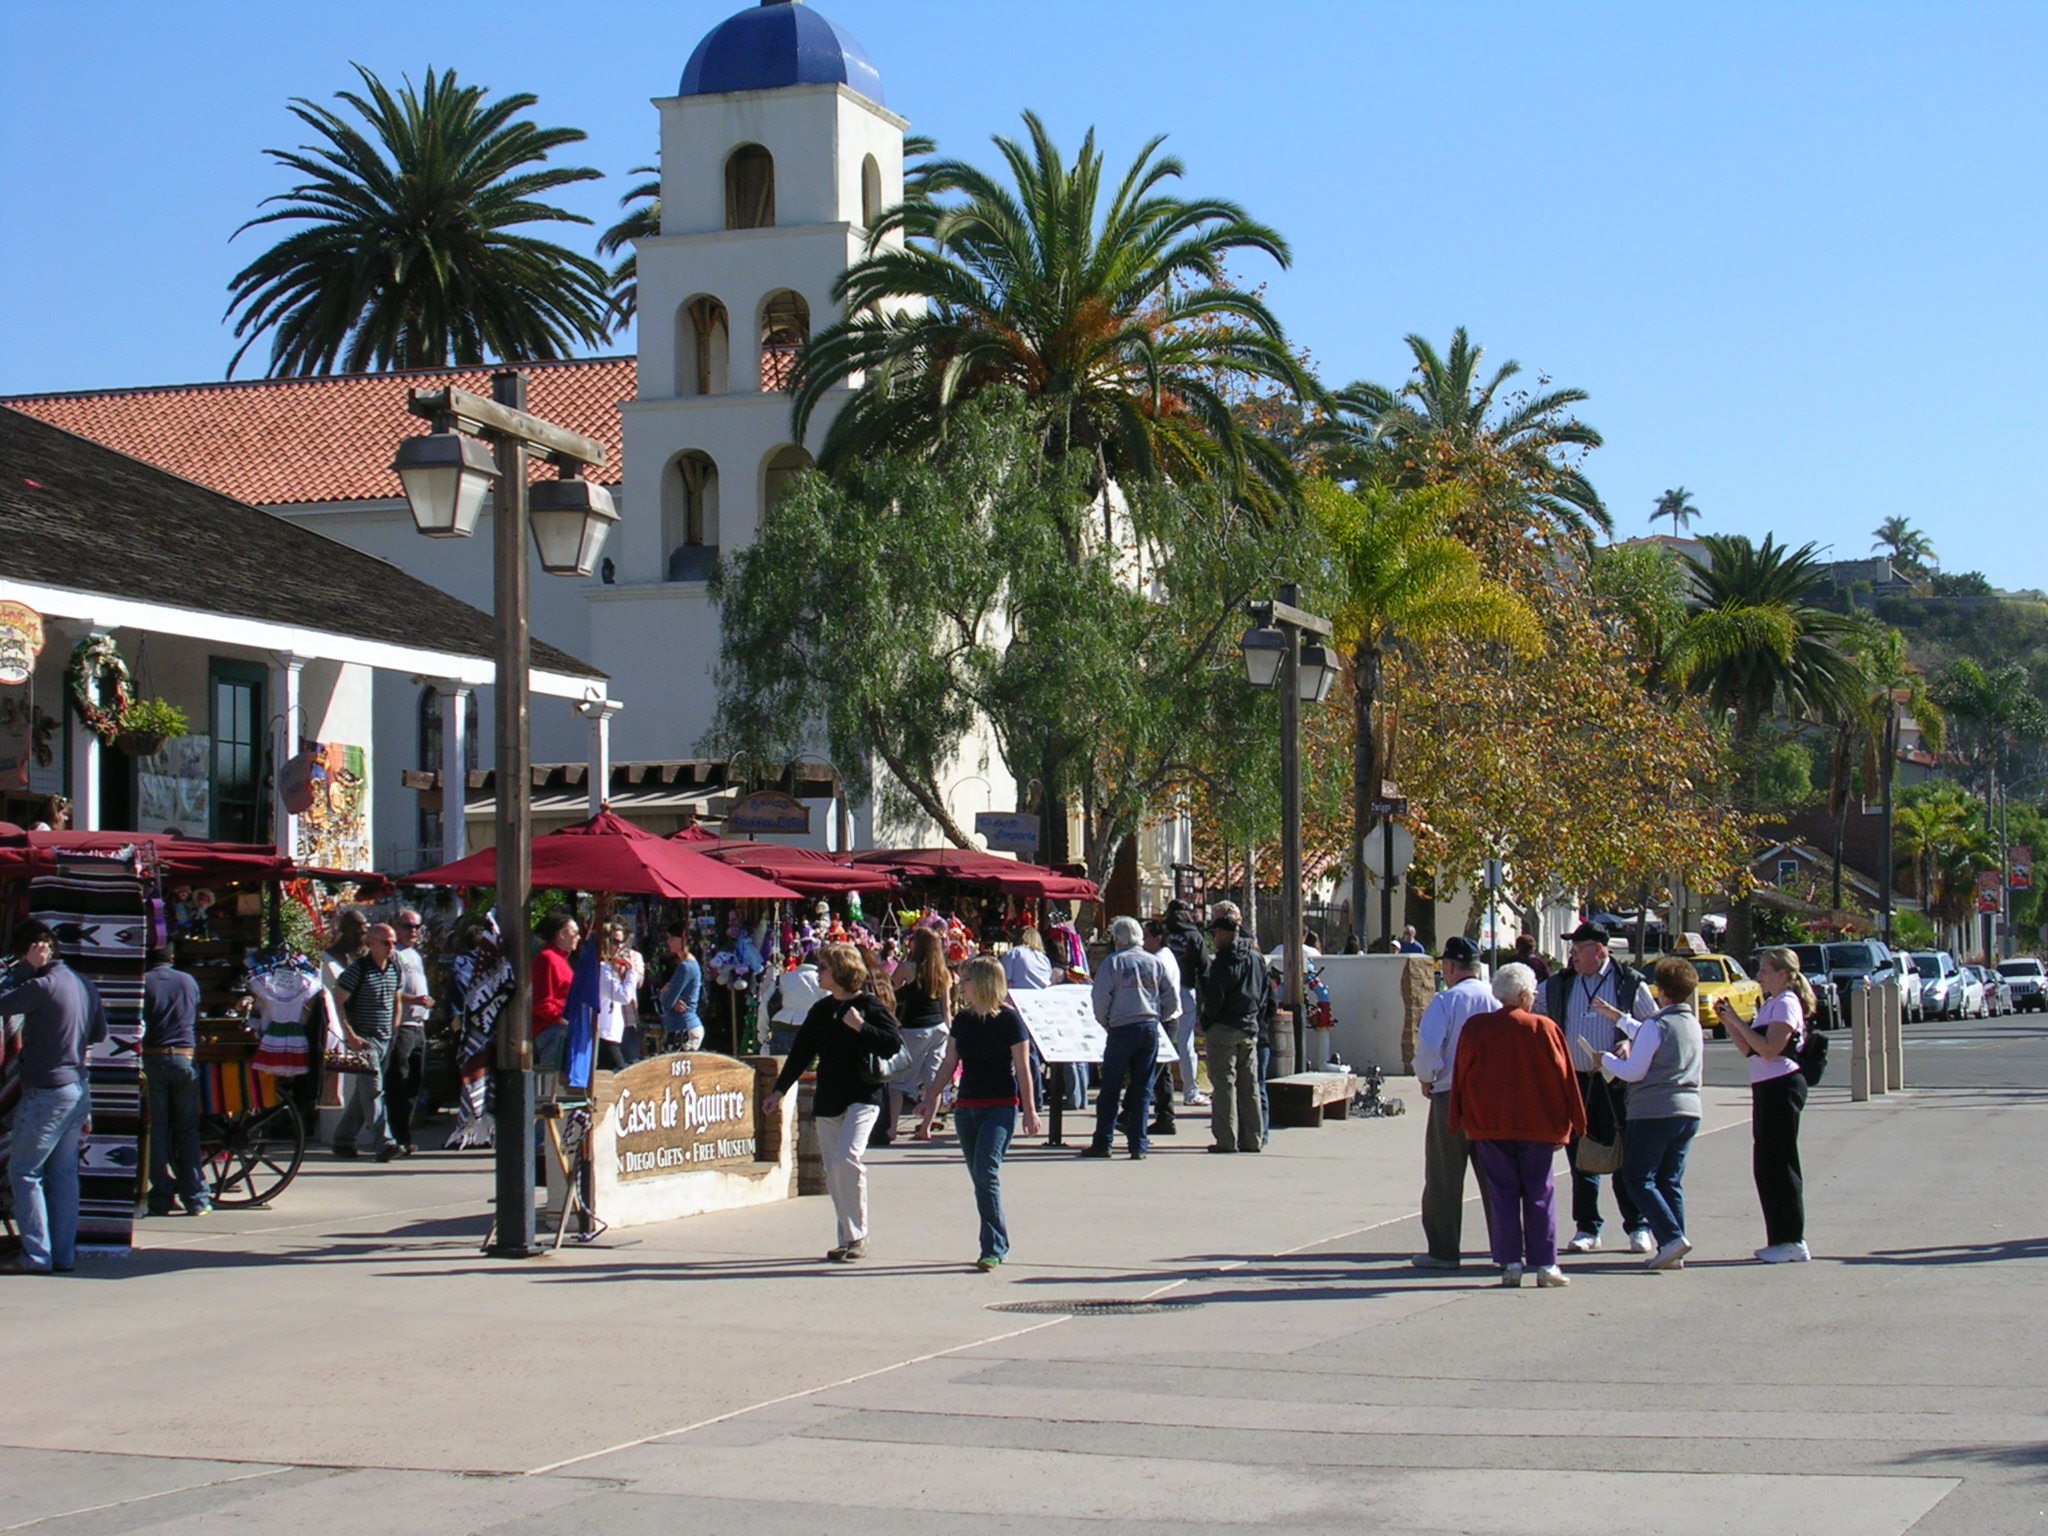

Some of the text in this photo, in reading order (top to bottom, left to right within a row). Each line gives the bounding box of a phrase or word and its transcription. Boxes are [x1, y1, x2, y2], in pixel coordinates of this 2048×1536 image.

[671, 1060, 692, 1076] 1853
[615, 1081, 744, 1137] Casa de Aguirre
[626, 1151, 655, 1172] DIEGO
[657, 1147, 684, 1168] GIFTS
[693, 1142, 716, 1162] FREE
[717, 1138, 756, 1158] MUSEUM
